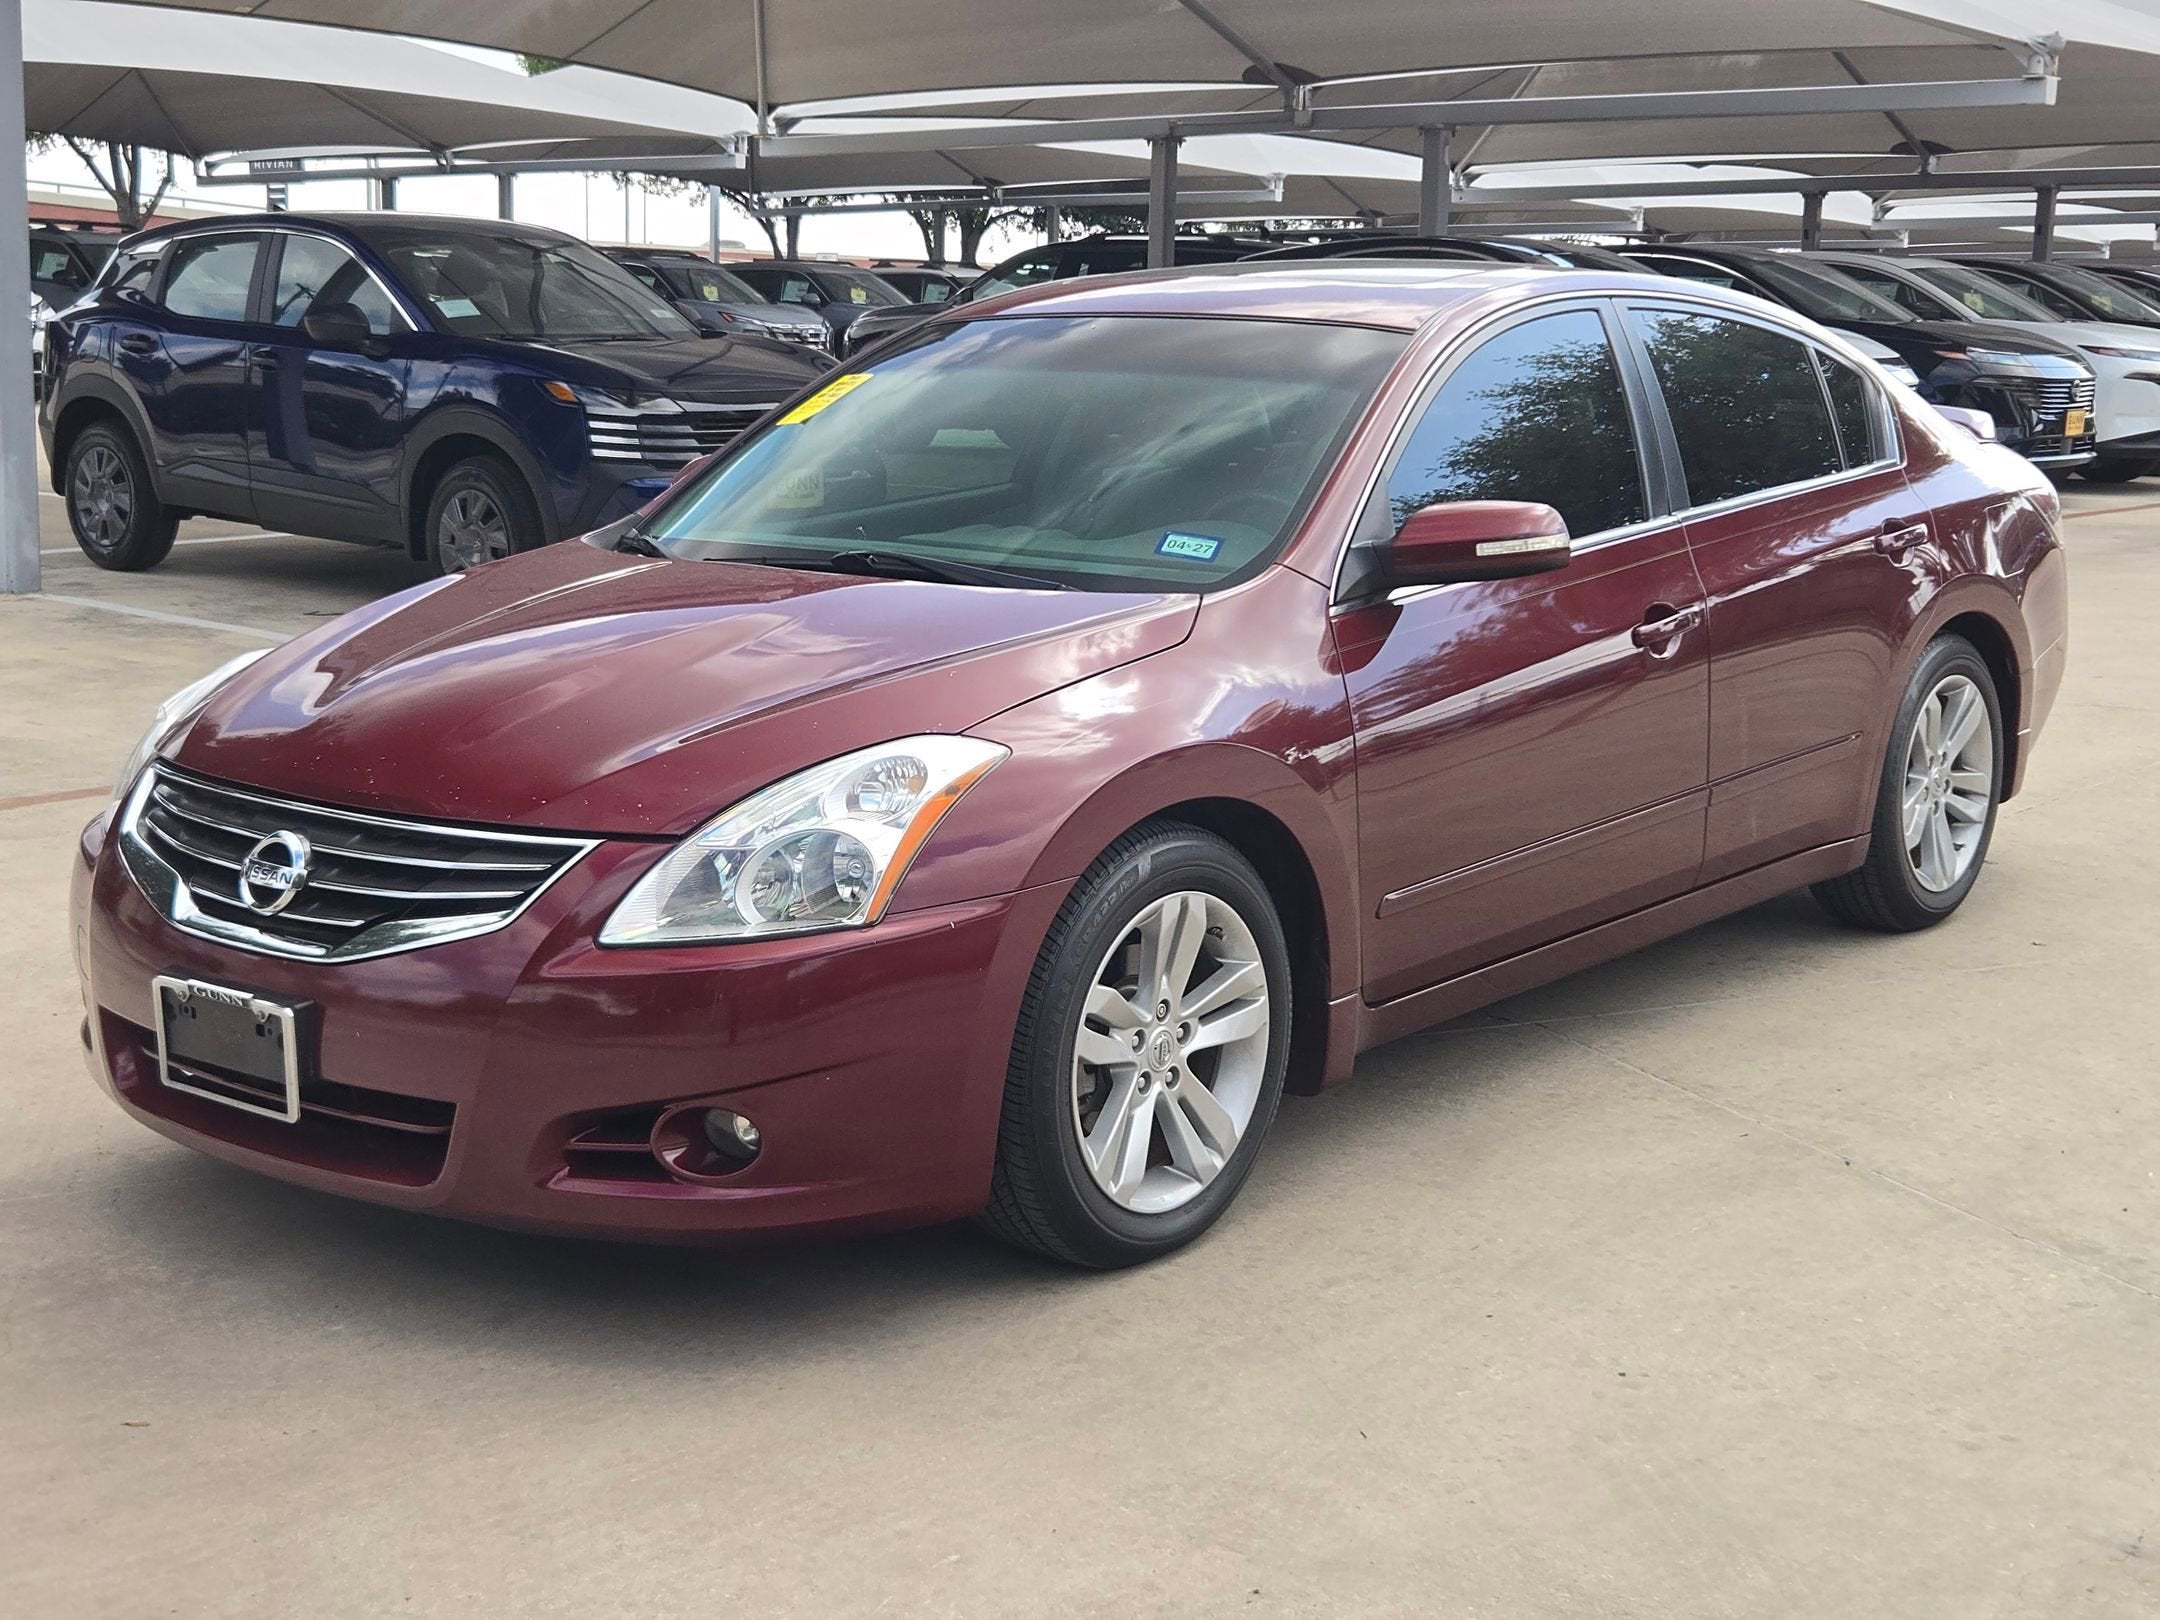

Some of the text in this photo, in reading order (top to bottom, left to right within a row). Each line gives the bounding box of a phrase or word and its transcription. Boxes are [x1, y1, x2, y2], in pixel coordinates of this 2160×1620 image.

[253, 160, 294, 170] RIVIAN
[777, 471, 820, 491] UNN
[240, 863, 293, 885] NISSAN
[193, 985, 245, 1008] GUNN
